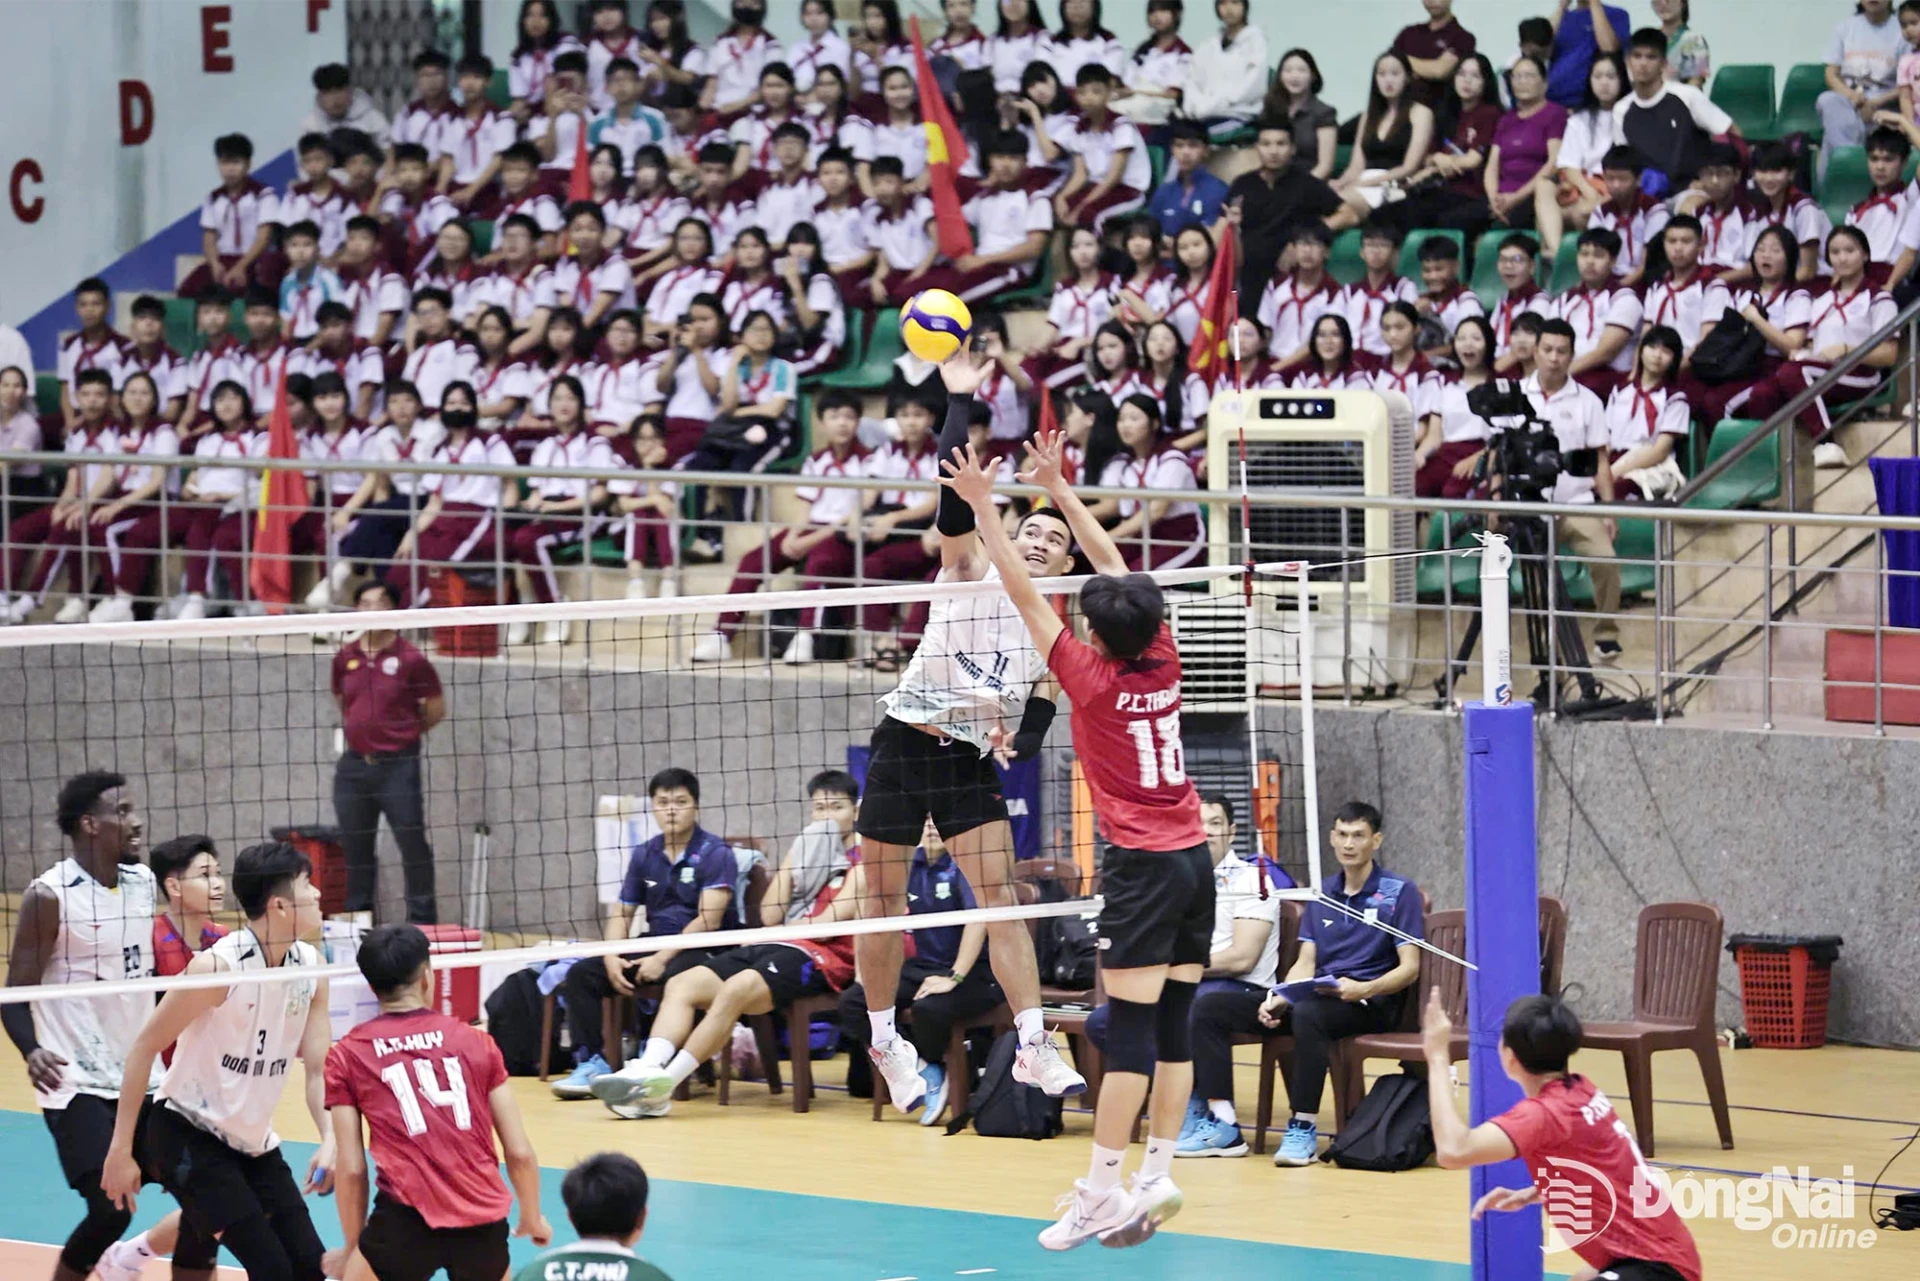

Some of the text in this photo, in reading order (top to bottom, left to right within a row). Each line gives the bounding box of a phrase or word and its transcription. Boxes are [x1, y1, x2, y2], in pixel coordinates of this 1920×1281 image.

[201, 5, 234, 73] E
[118, 79, 154, 146] D
[9, 158, 44, 223] C
[1126, 710, 1186, 788] 18
[256, 1029, 267, 1056] 3
[381, 1056, 472, 1136] 14
